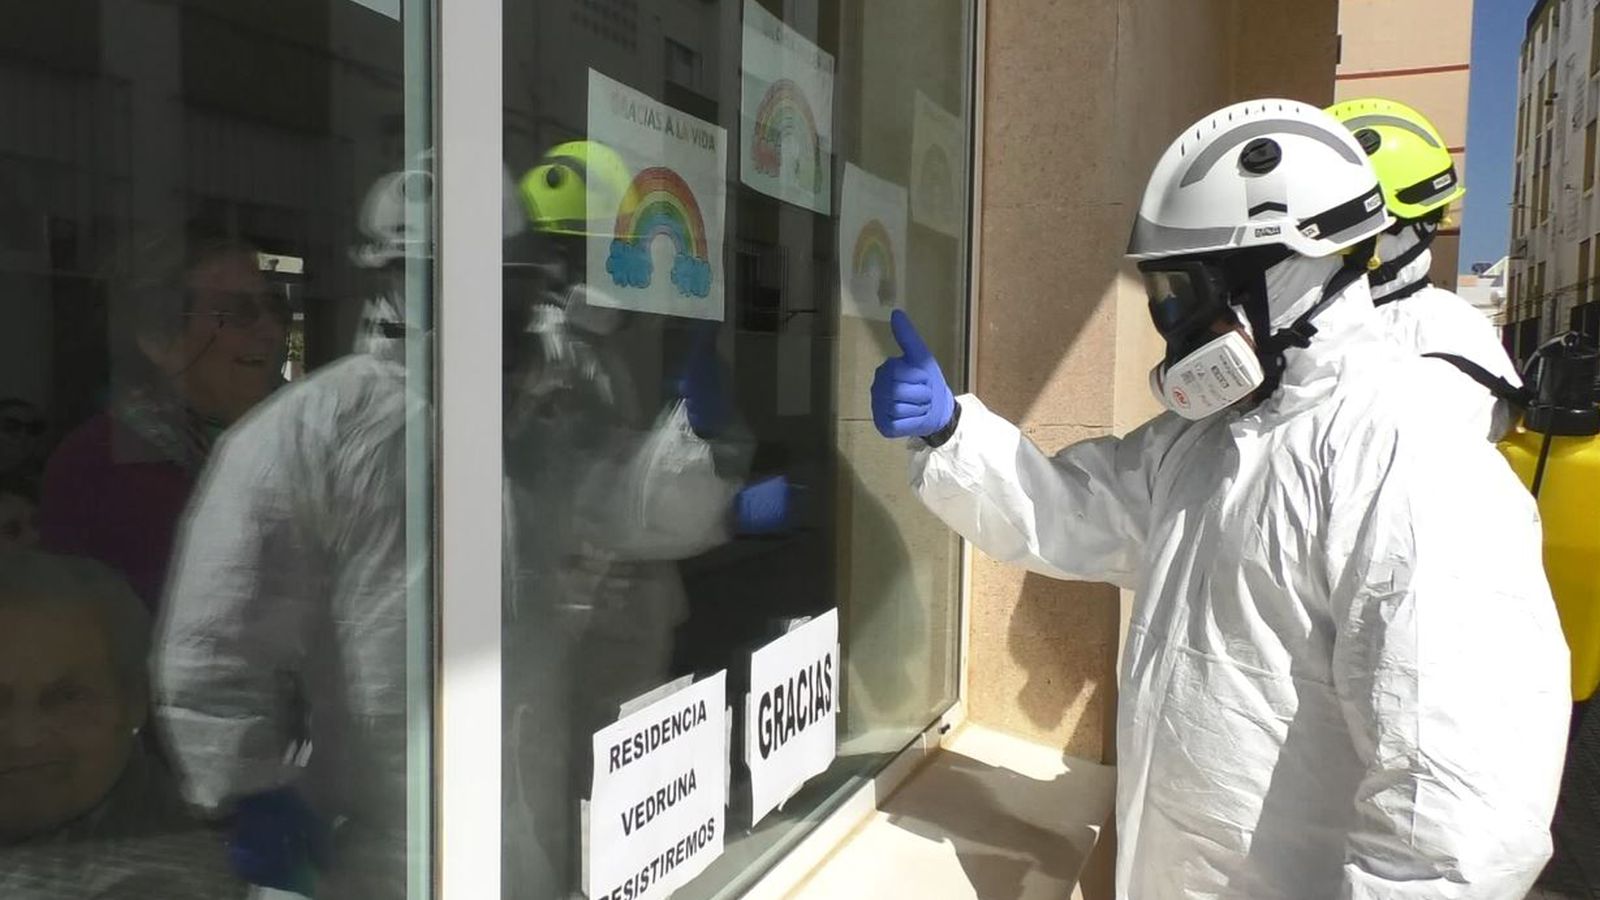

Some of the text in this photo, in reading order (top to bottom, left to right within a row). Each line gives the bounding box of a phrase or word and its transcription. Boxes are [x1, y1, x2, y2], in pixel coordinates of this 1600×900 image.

[610, 90, 662, 131] ACIAS
[690, 128, 716, 153] VIDA
[609, 699, 707, 773] RESIDENCIA
[758, 652, 832, 760] GRACIAS
[621, 768, 697, 837] VEDRUNA
